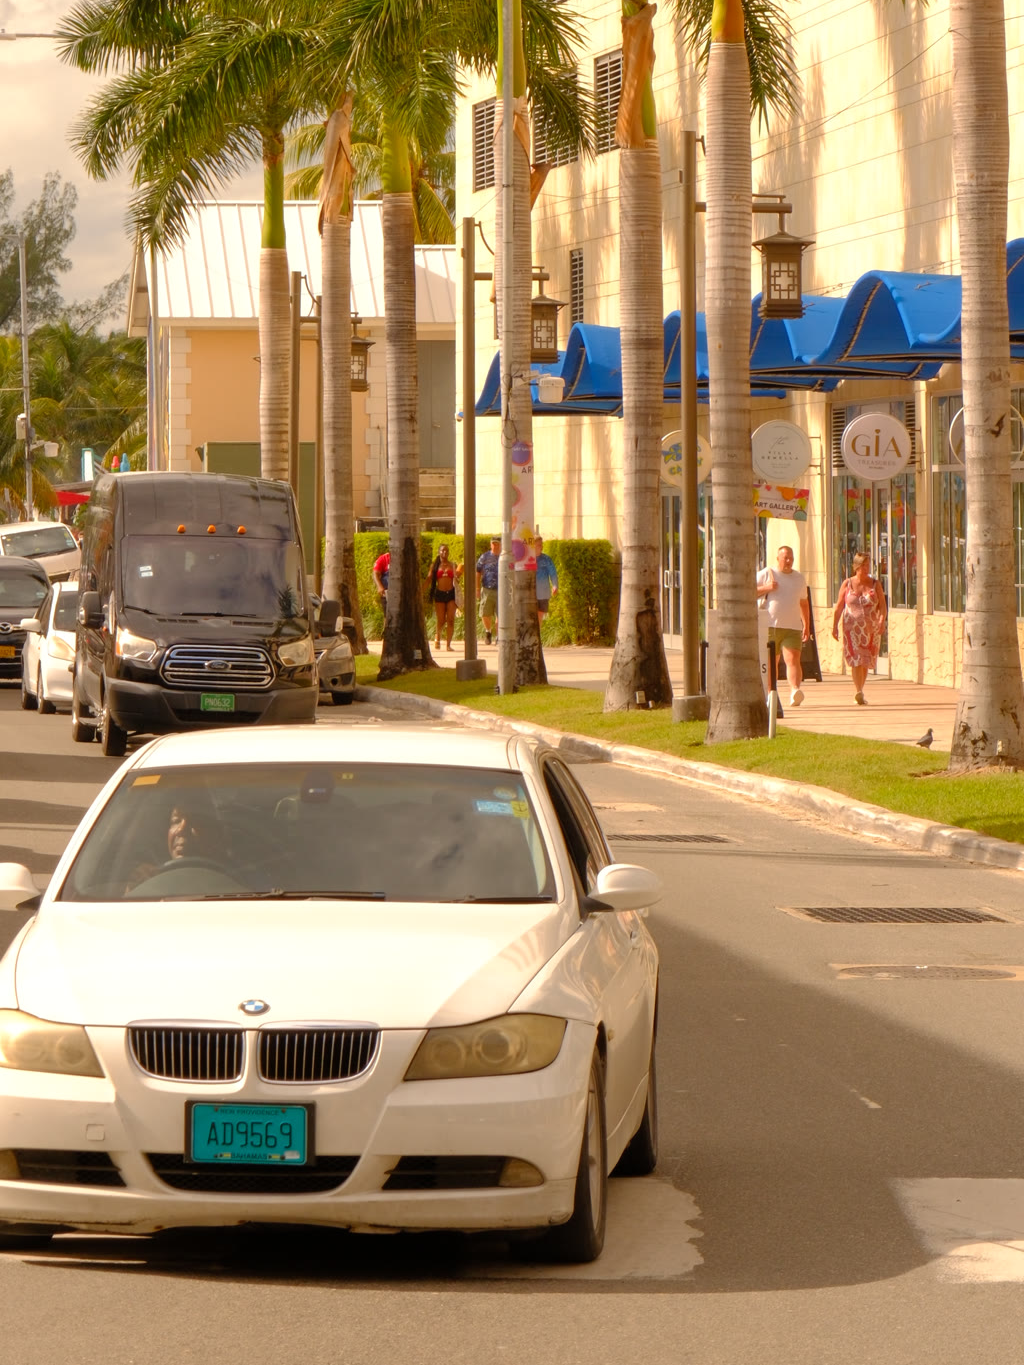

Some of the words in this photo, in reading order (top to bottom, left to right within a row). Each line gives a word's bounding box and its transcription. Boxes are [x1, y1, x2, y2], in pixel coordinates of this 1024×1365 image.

[521, 465, 534, 474] AR
[754, 501, 768, 509] ART
[769, 502, 800, 511] GALLERY
[237, 1108, 280, 1116] PROVIDENCE
[206, 1120, 293, 1149] AD9569
